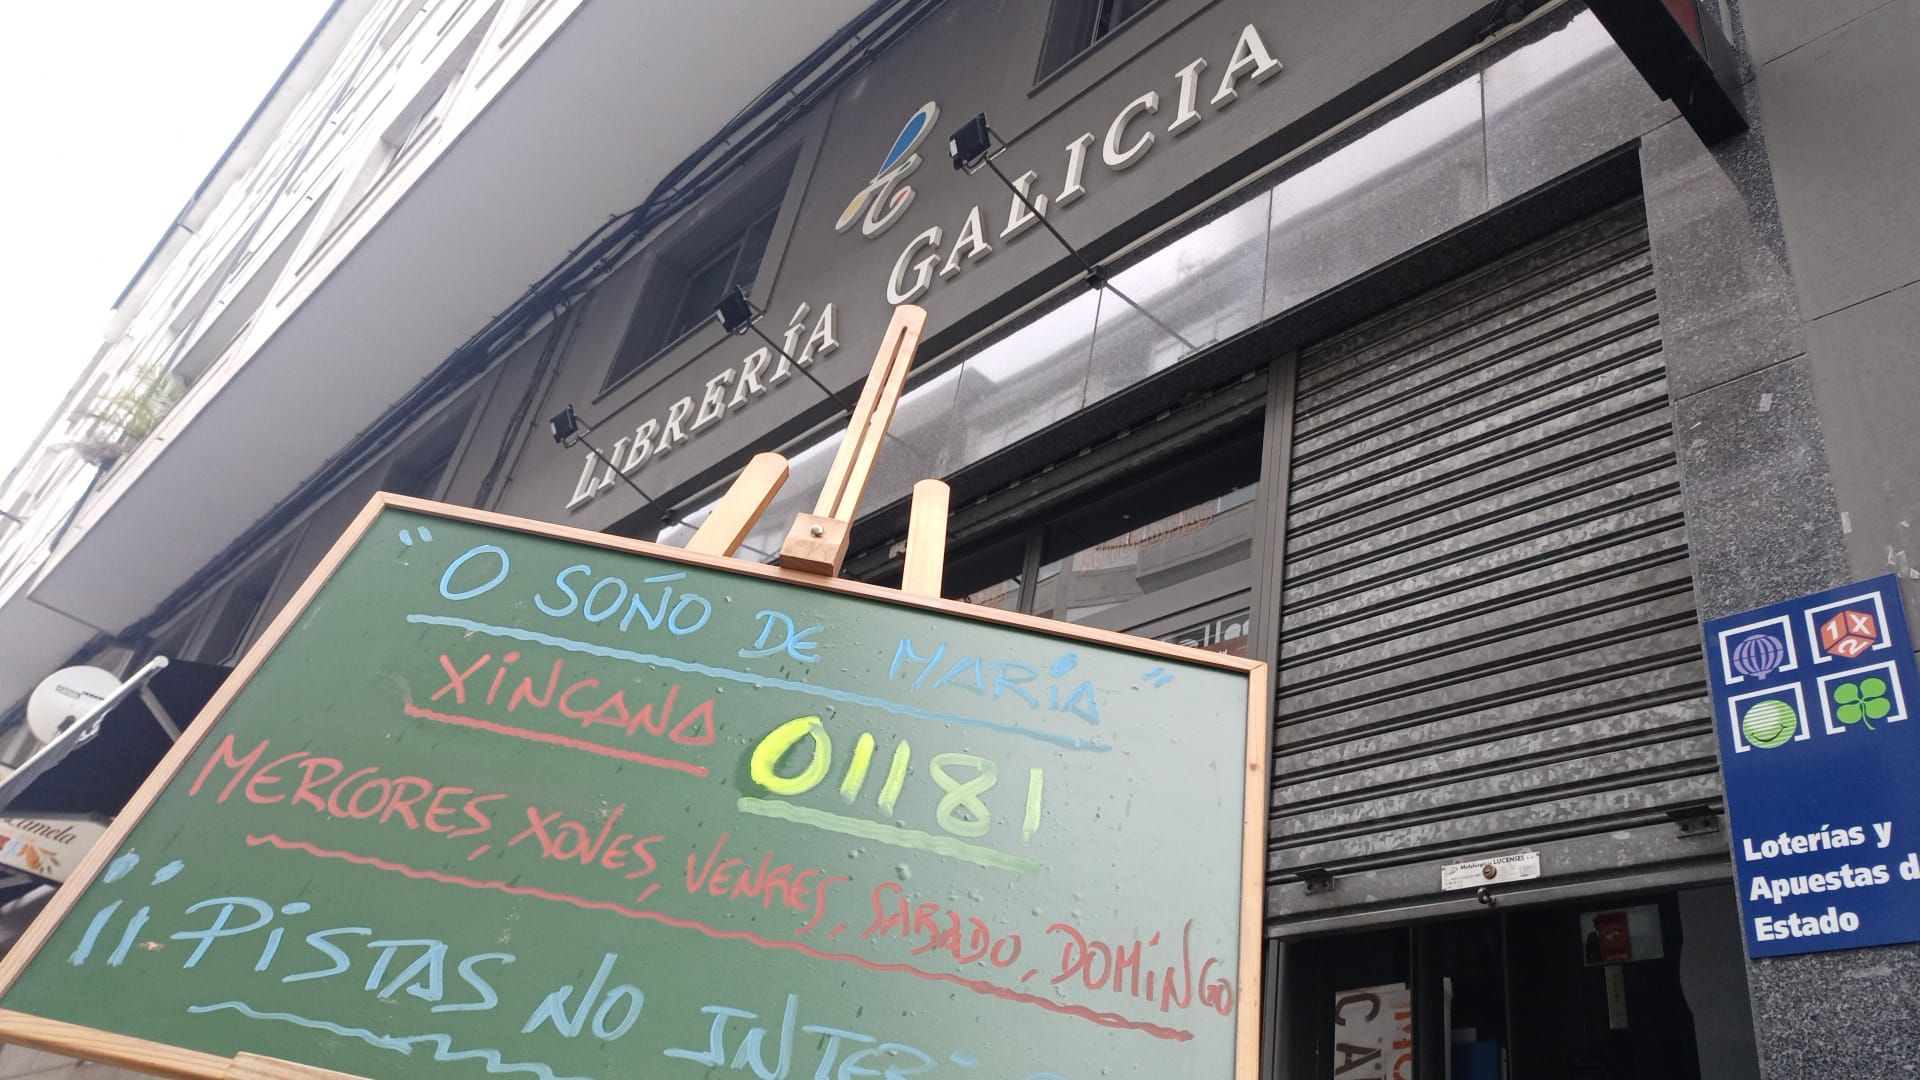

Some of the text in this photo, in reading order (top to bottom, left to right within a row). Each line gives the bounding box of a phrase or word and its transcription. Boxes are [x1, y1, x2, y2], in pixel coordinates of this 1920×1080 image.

[565, 24, 1283, 509] LIBRERÍA GALICIA
[535, 564, 711, 635] SOÑO
[739, 610, 824, 662] DE
[750, 716, 1043, 845] 01181
[1743, 821, 1892, 861] Loterías y
[1750, 864, 1890, 904] Apuestas
[1754, 907, 1859, 941] Estado
[522, 952, 646, 1041] NO
